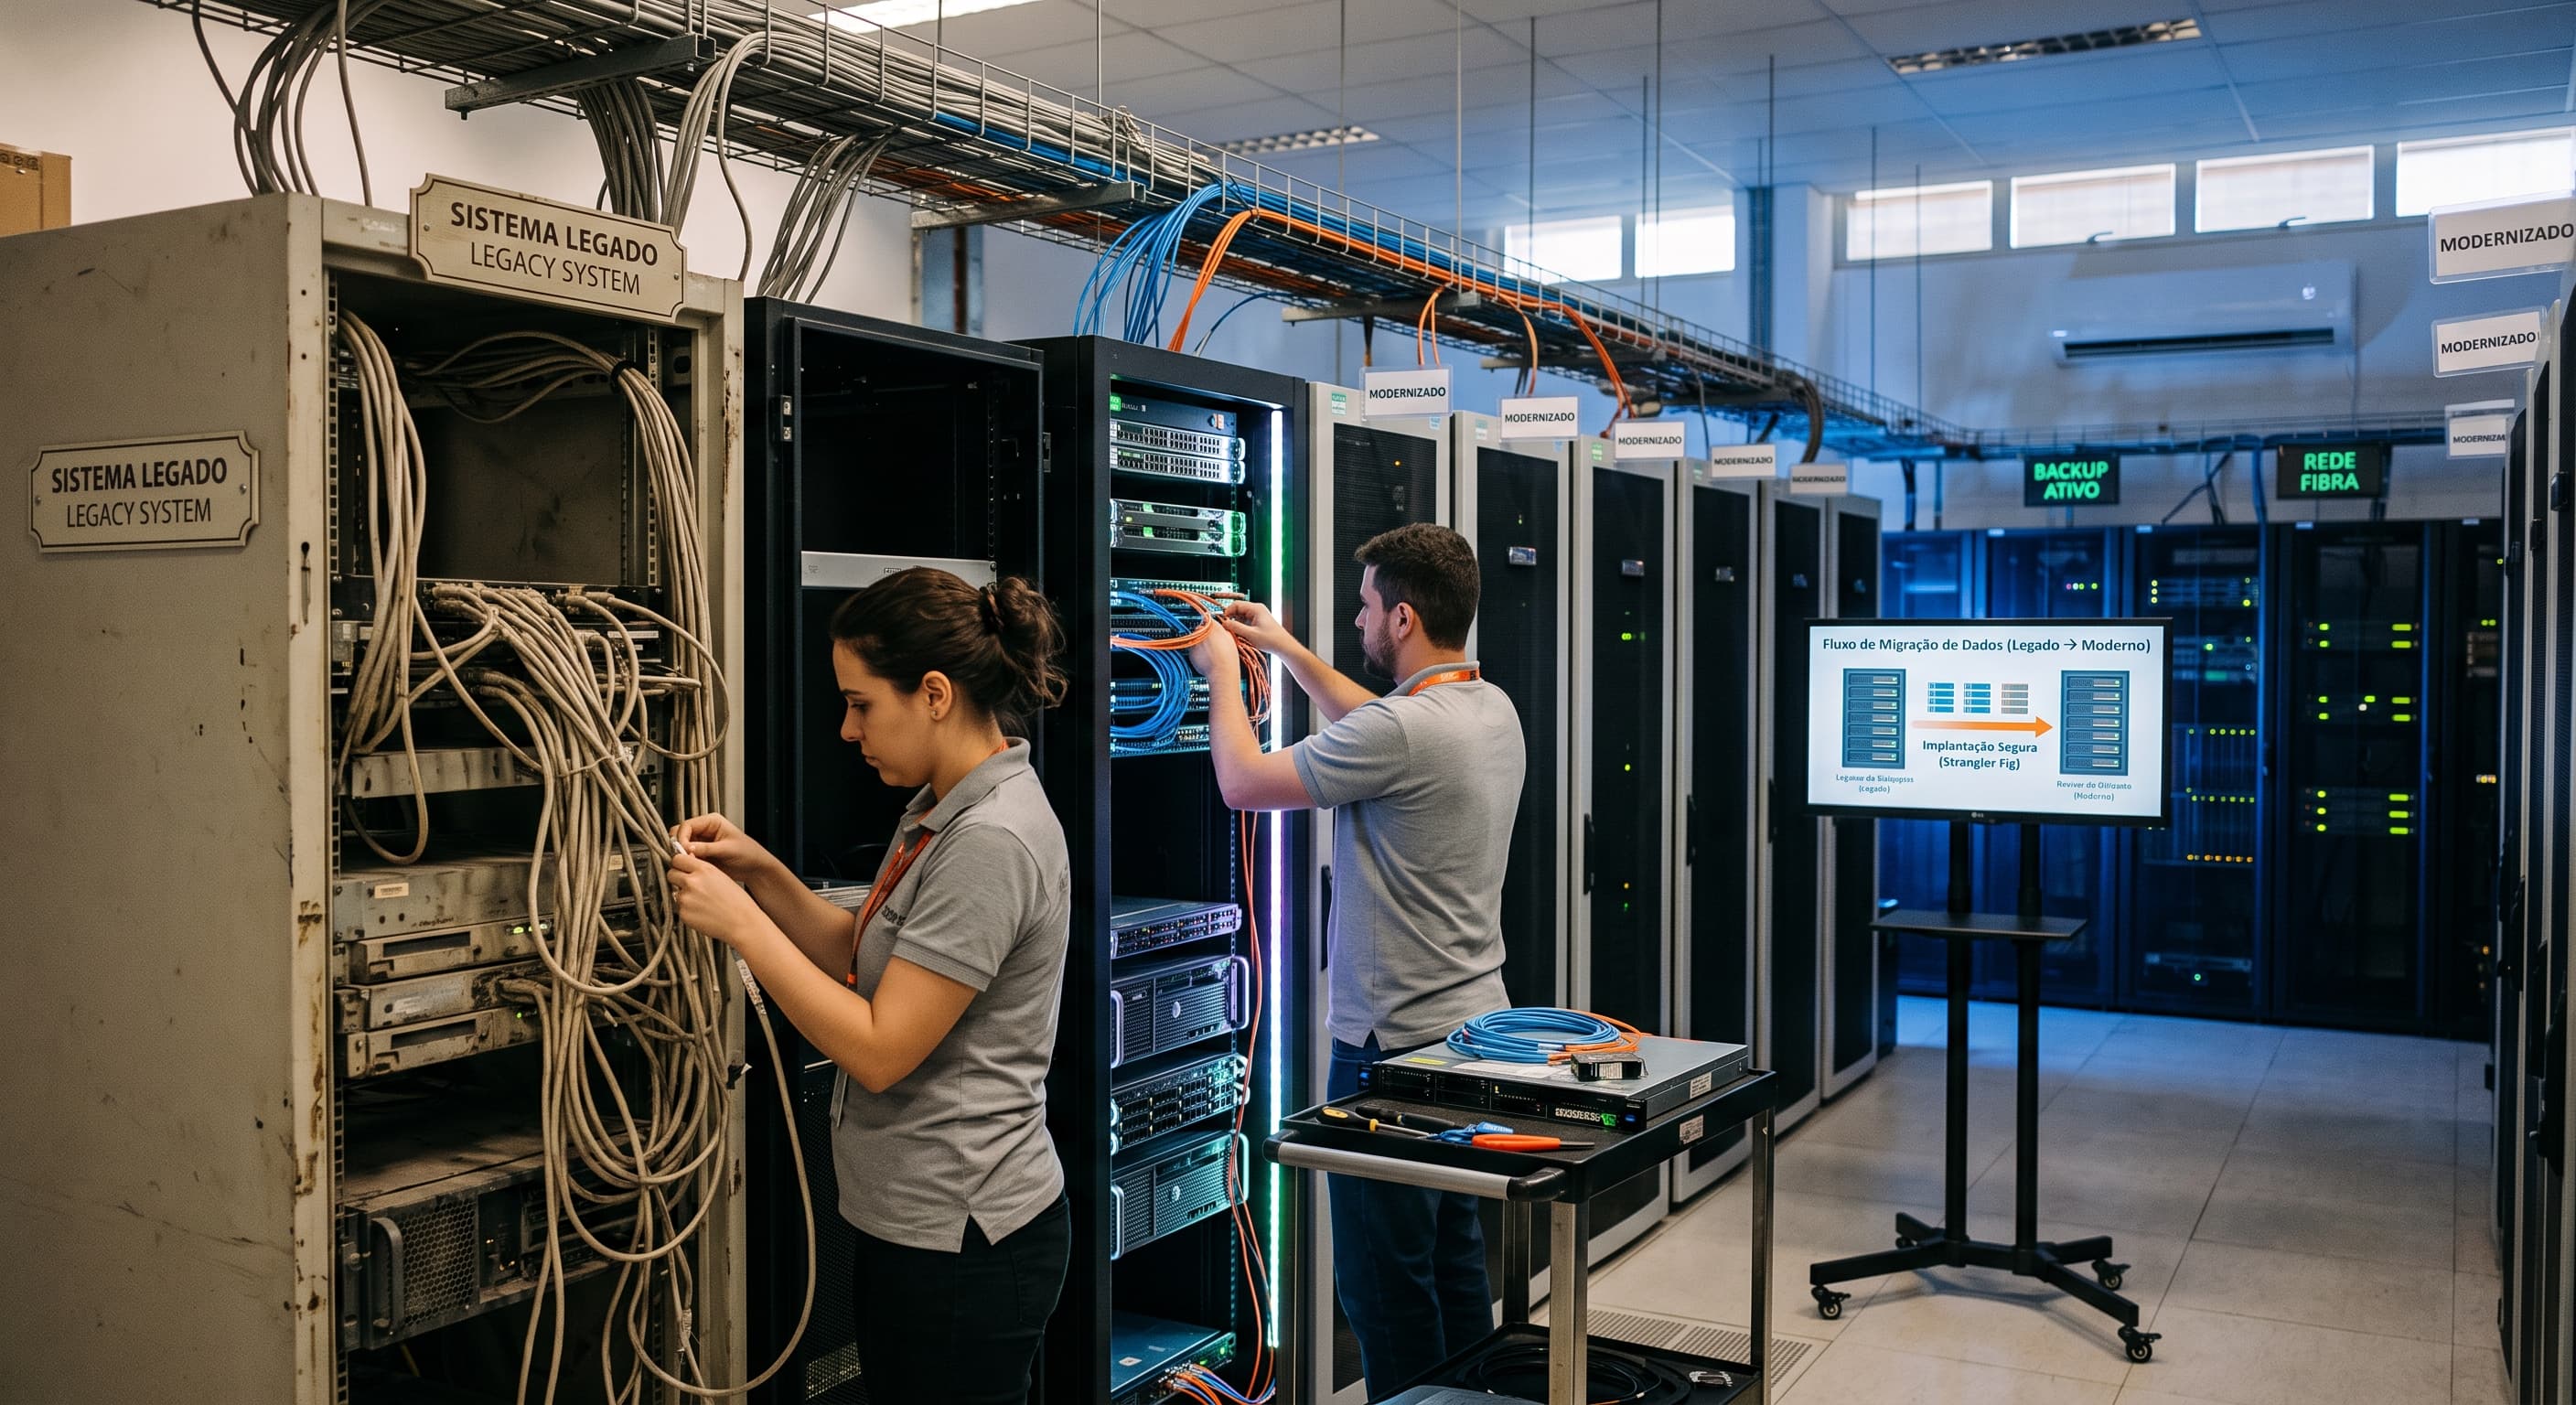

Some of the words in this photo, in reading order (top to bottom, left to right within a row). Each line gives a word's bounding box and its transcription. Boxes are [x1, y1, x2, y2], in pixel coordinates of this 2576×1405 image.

[451, 202, 559, 246] SISTEMA
[566, 226, 658, 266] LEGADO
[2441, 223, 2574, 252] MODERNIZADO
[471, 241, 556, 279] LEGACY
[562, 260, 639, 295] SYSTEM
[1369, 387, 1446, 399] MODERNIZADO
[1505, 412, 1575, 423] MODERNIZADO
[1618, 435, 1682, 445] MODERNIZADO
[2303, 451, 2356, 470] REDE
[51, 463, 136, 494] SISTEMA
[142, 457, 228, 488] LEGADO
[2034, 461, 2109, 481] BACKUP
[2300, 471, 2359, 491] FIBRA
[2044, 480, 2100, 500] ATIVO
[67, 501, 135, 528] LEGACY
[139, 498, 211, 525] SYSTEM
[1823, 638, 1856, 650] Fluxo
[1860, 638, 1876, 650] de
[1879, 638, 1938, 653] Migração
[1942, 638, 1959, 650] de
[1962, 638, 2003, 651] Dados
[2007, 638, 2060, 654] (Legado
[2081, 638, 2151, 654] Moderno)
[1923, 740, 1995, 754] Implantação
[1998, 742, 2038, 756] Segura
[1938, 756, 1997, 770] (Strangler
[2000, 757, 2021, 771] Fig)
